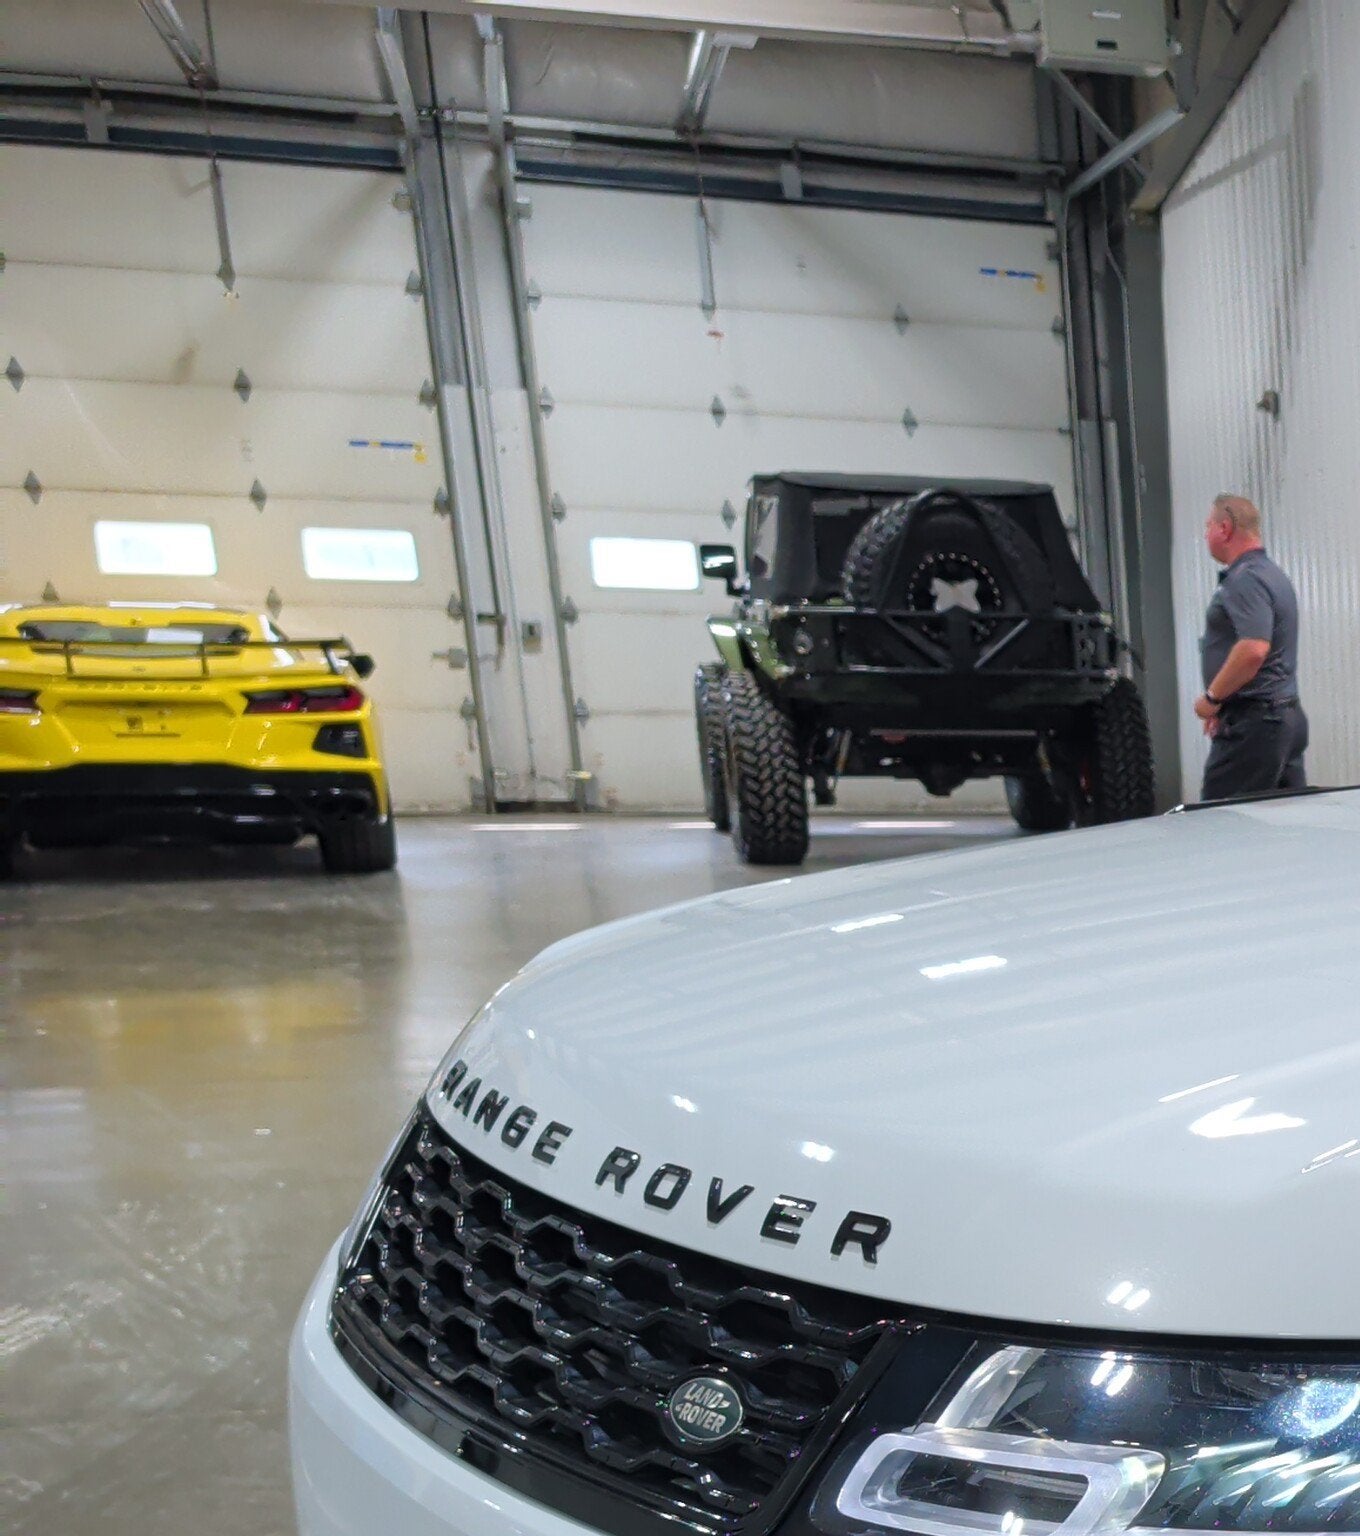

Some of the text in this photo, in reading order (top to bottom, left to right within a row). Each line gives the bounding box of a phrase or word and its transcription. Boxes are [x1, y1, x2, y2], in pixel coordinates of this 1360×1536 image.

[441, 1059, 892, 1265] RANGE ROVER
[683, 1382, 724, 1409] LAND
[678, 1402, 727, 1434] ROVER
